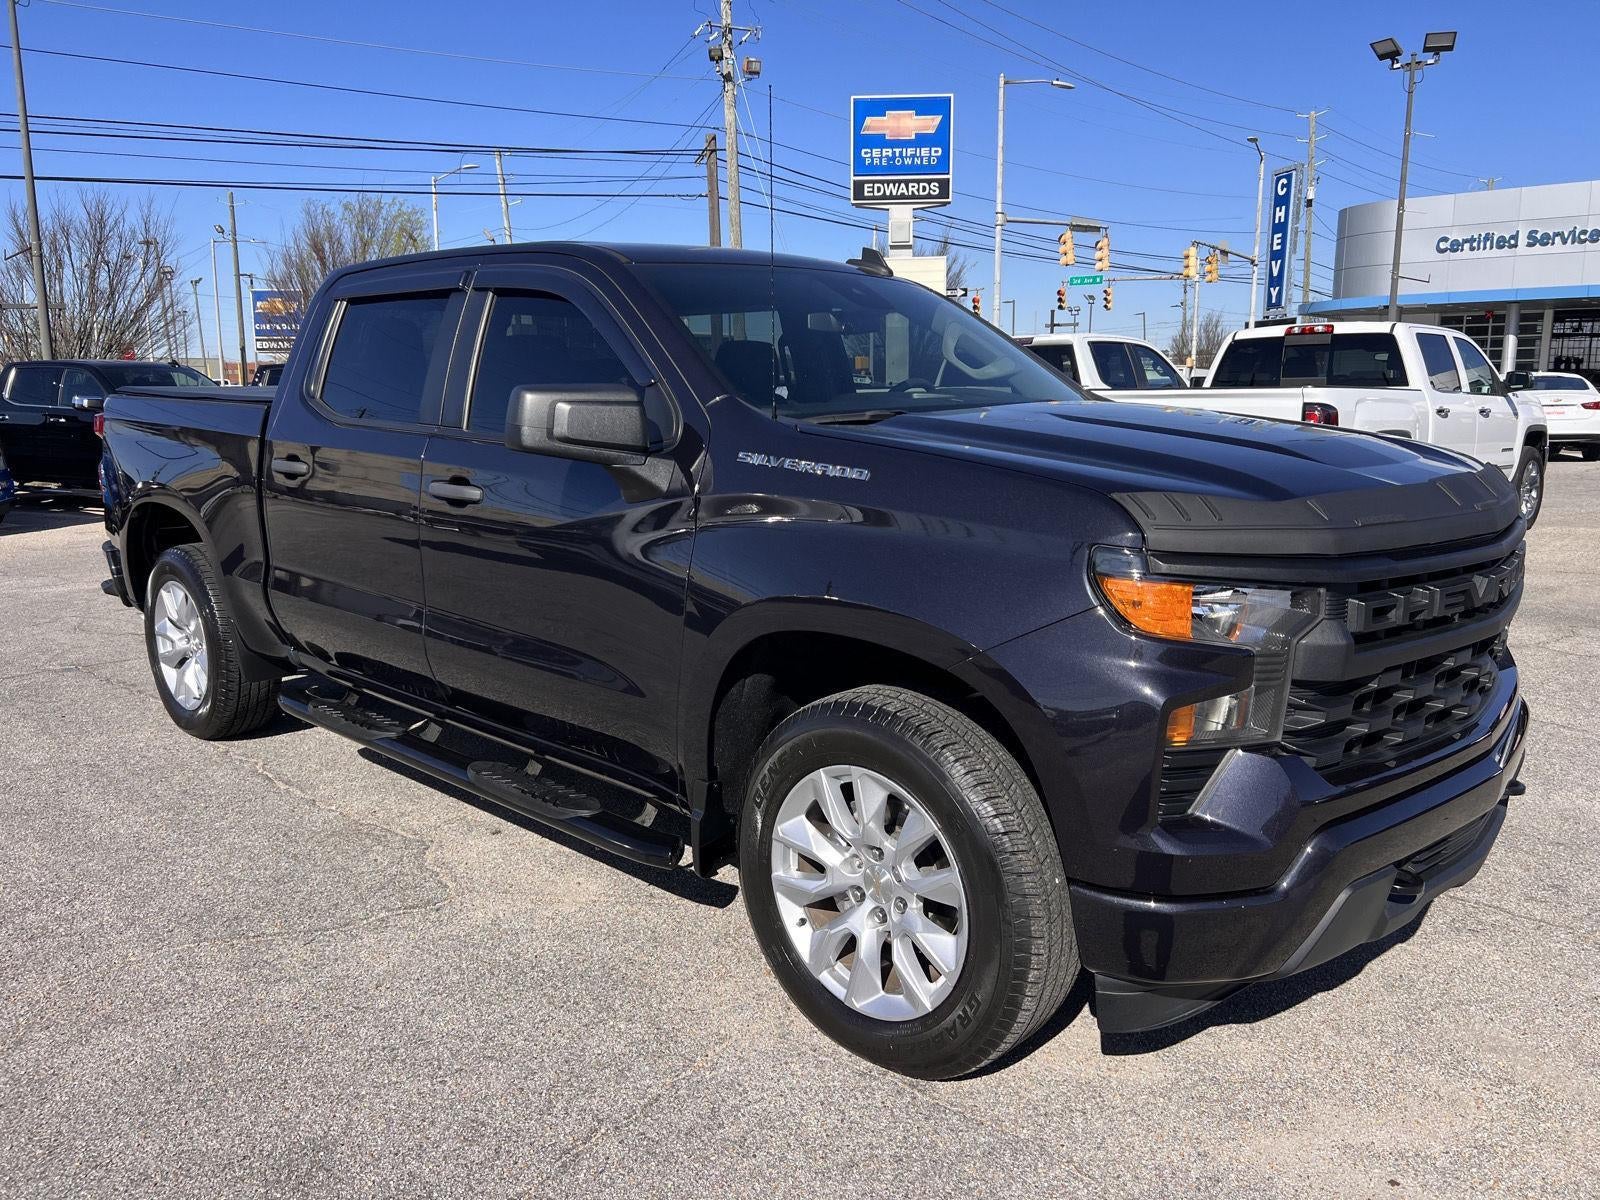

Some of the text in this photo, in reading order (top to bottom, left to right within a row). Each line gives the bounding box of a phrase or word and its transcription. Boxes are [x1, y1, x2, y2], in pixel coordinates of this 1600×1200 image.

[861, 147, 942, 158] CERTIFIED
[865, 157, 938, 166] PRE-OWNED
[863, 181, 940, 197] EDWARDS
[1270, 178, 1288, 304] CHEVY
[1435, 226, 1600, 254] Certified Service
[736, 450, 871, 481] SILVERADO
